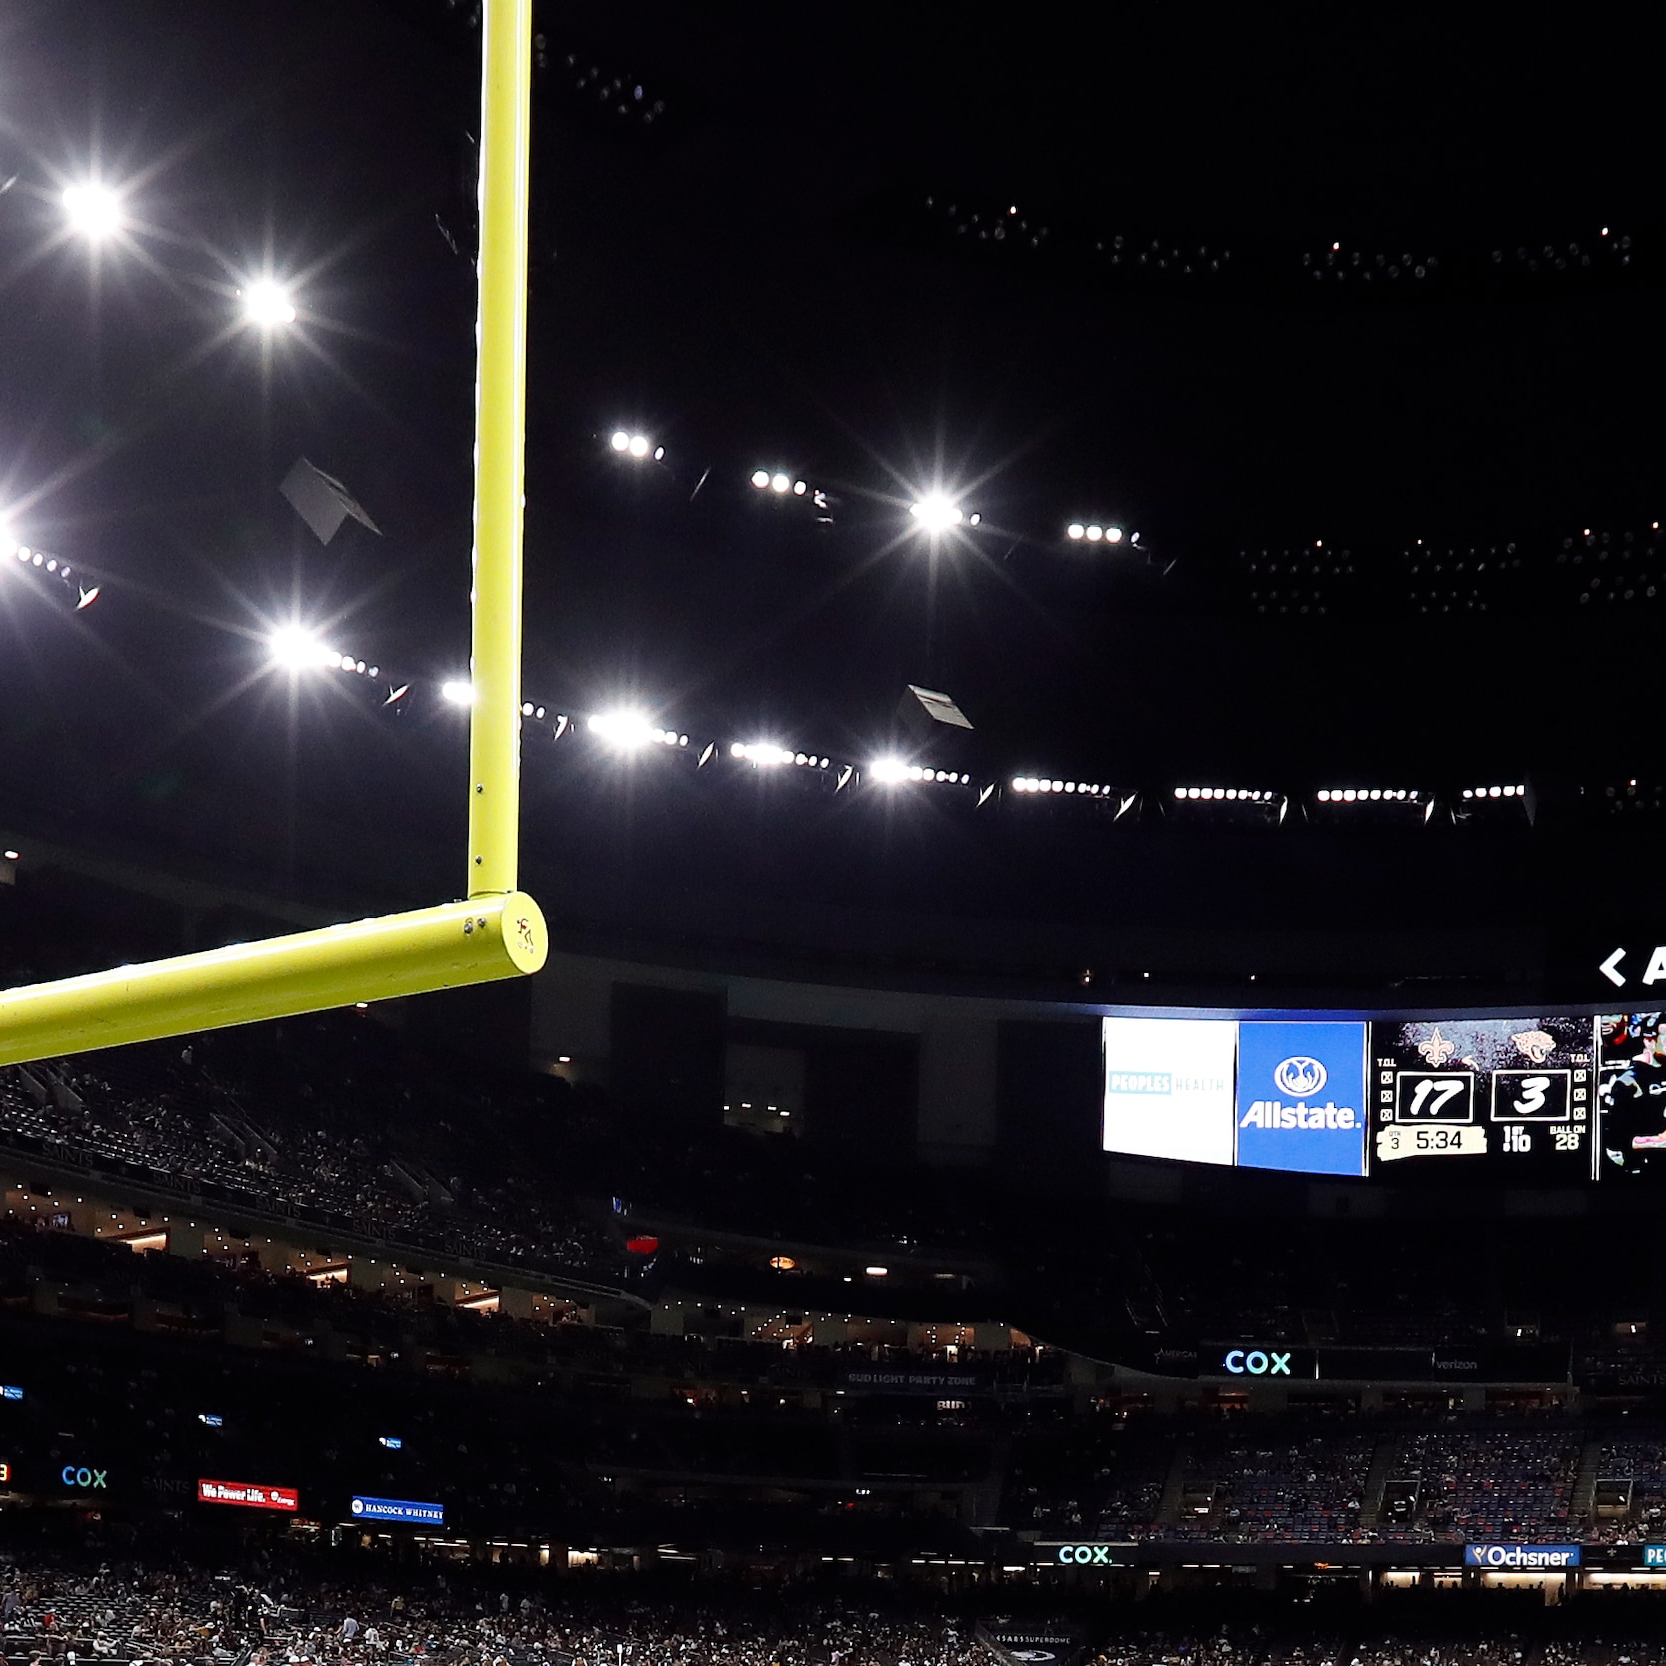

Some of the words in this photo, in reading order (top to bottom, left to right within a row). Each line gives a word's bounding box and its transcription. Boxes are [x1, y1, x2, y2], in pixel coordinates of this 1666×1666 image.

[1111, 1073, 1171, 1093] PEOPLES
[1175, 1077, 1225, 1092] HEALTH
[1409, 1078, 1465, 1116] 17
[1513, 1076, 1551, 1114] 3
[1390, 1137, 1401, 1151] 3
[1416, 1130, 1464, 1151] 5:34
[1554, 1134, 1580, 1151] 28
[1224, 1349, 1292, 1376] COX
[1436, 1360, 1479, 1371] verizon
[873, 1374, 906, 1384] LIGHT
[909, 1375, 945, 1386] PARTY
[947, 1376, 977, 1386] ZONE
[61, 1465, 107, 1489] COX
[201, 1483, 218, 1498] We
[218, 1485, 247, 1501] Power
[246, 1488, 266, 1503] Life.
[365, 1503, 404, 1516] HANCOCK
[405, 1507, 444, 1520] WHITNEY
[1486, 1545, 1570, 1567] Ochsner
